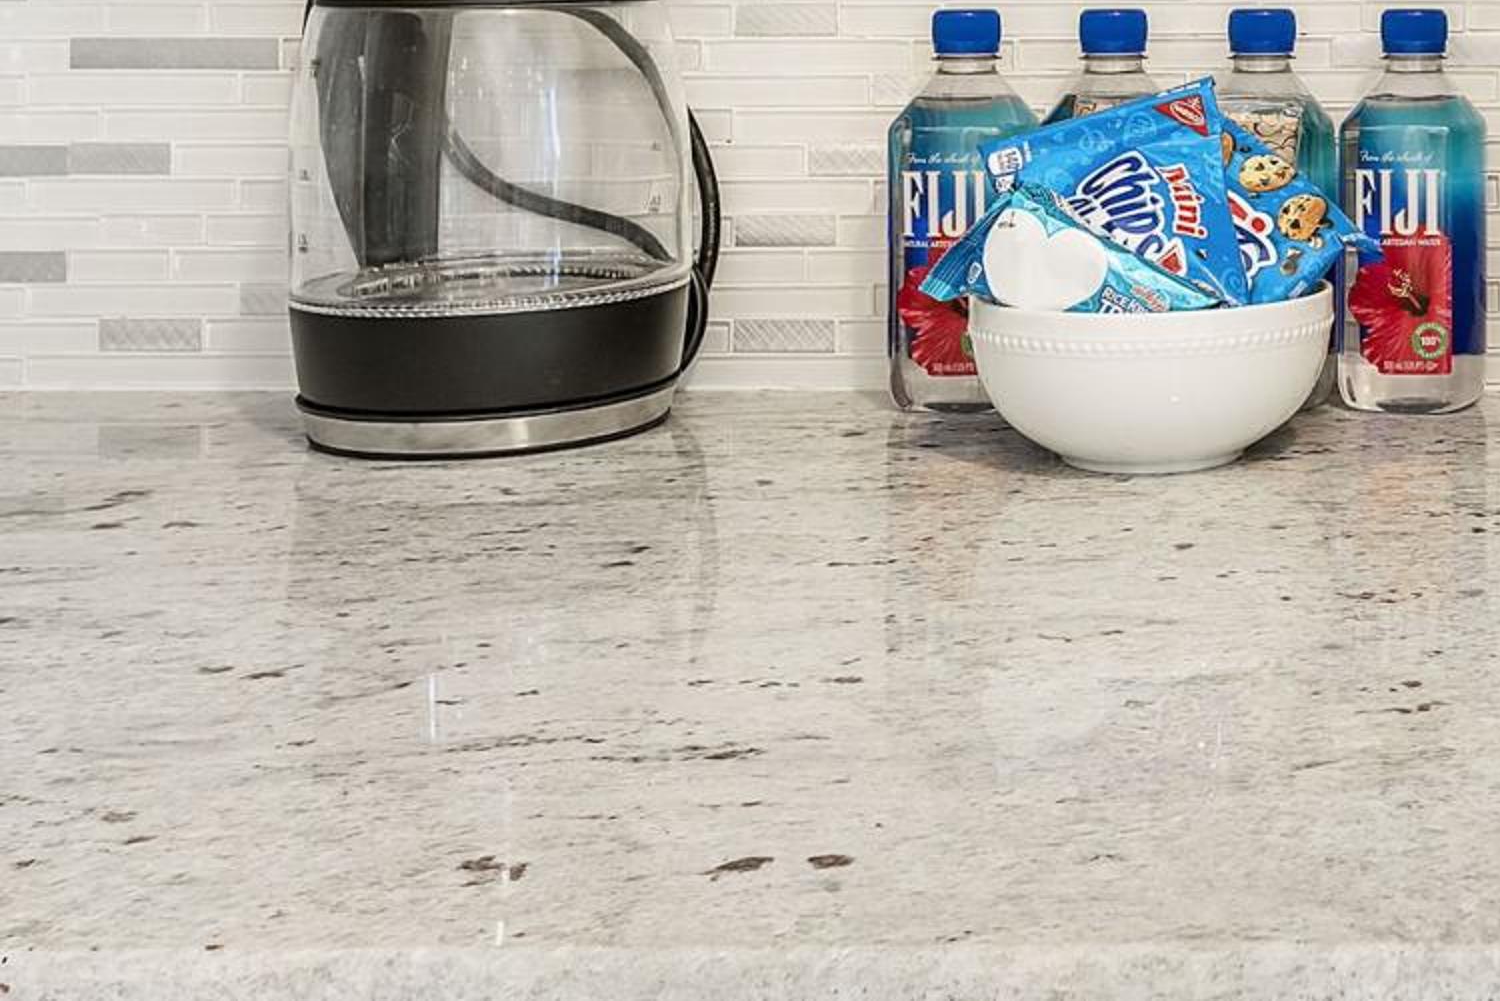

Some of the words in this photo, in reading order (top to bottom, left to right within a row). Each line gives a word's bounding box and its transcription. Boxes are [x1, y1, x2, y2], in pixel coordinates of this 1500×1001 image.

[902, 170, 985, 238] FIJI
[1157, 165, 1207, 238] Mini
[1355, 168, 1441, 236] FIJI
